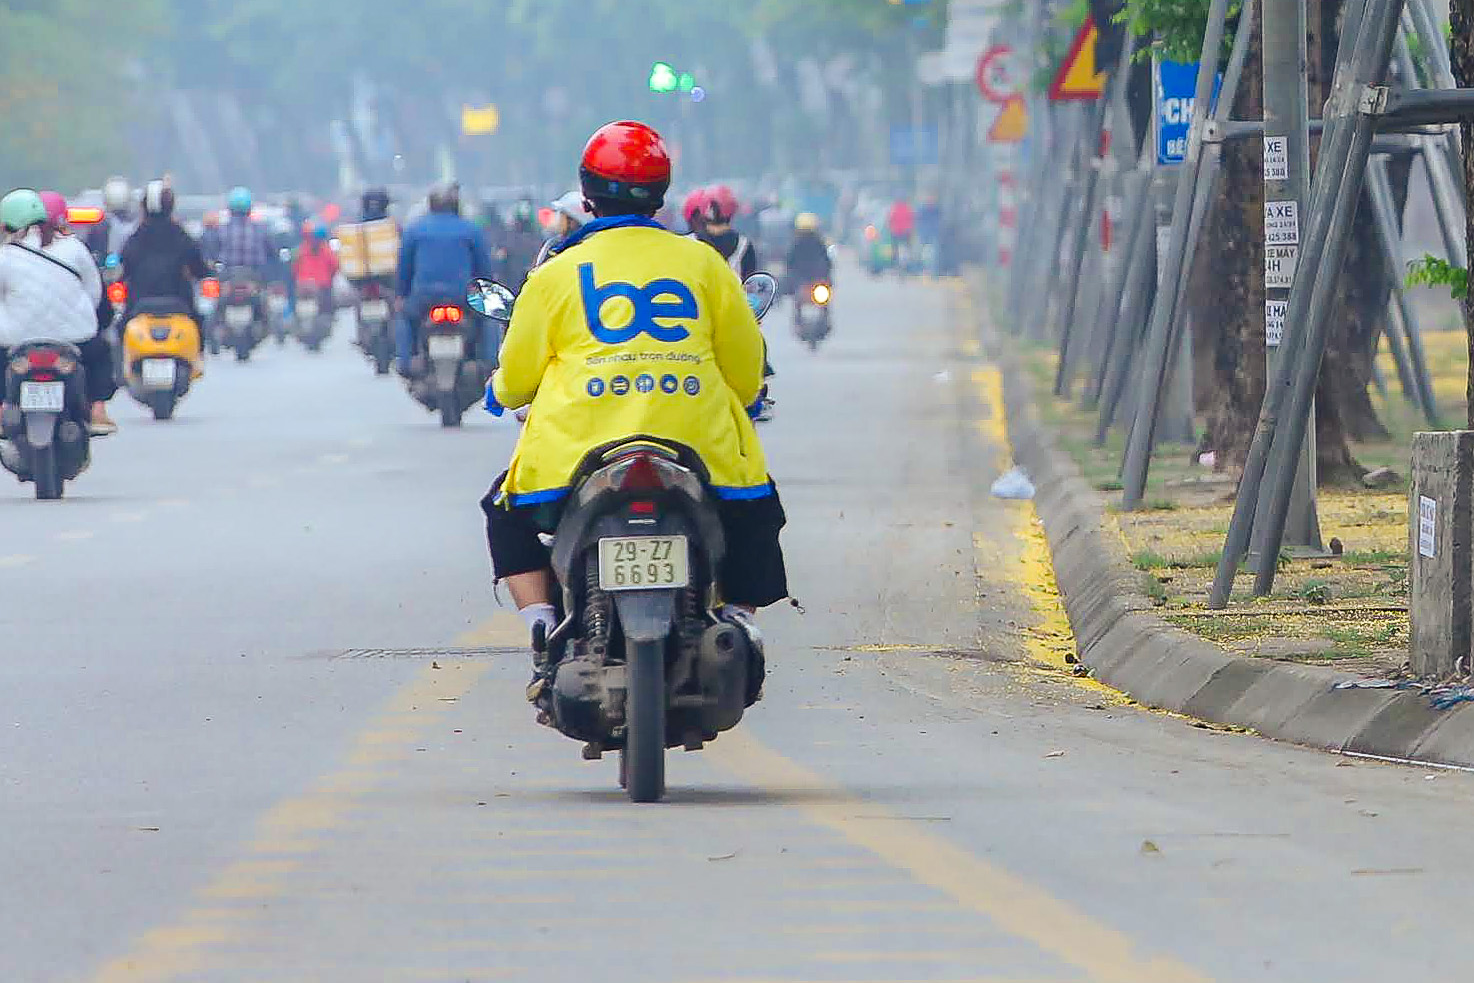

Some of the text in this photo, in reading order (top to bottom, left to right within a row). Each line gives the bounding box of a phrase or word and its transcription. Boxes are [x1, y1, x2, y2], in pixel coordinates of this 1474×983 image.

[1267, 140, 1282, 153] XE
[1276, 205, 1293, 217] XE
[578, 262, 699, 345] be
[613, 540, 673, 562] 29-Z7
[614, 563, 674, 585] 6693
